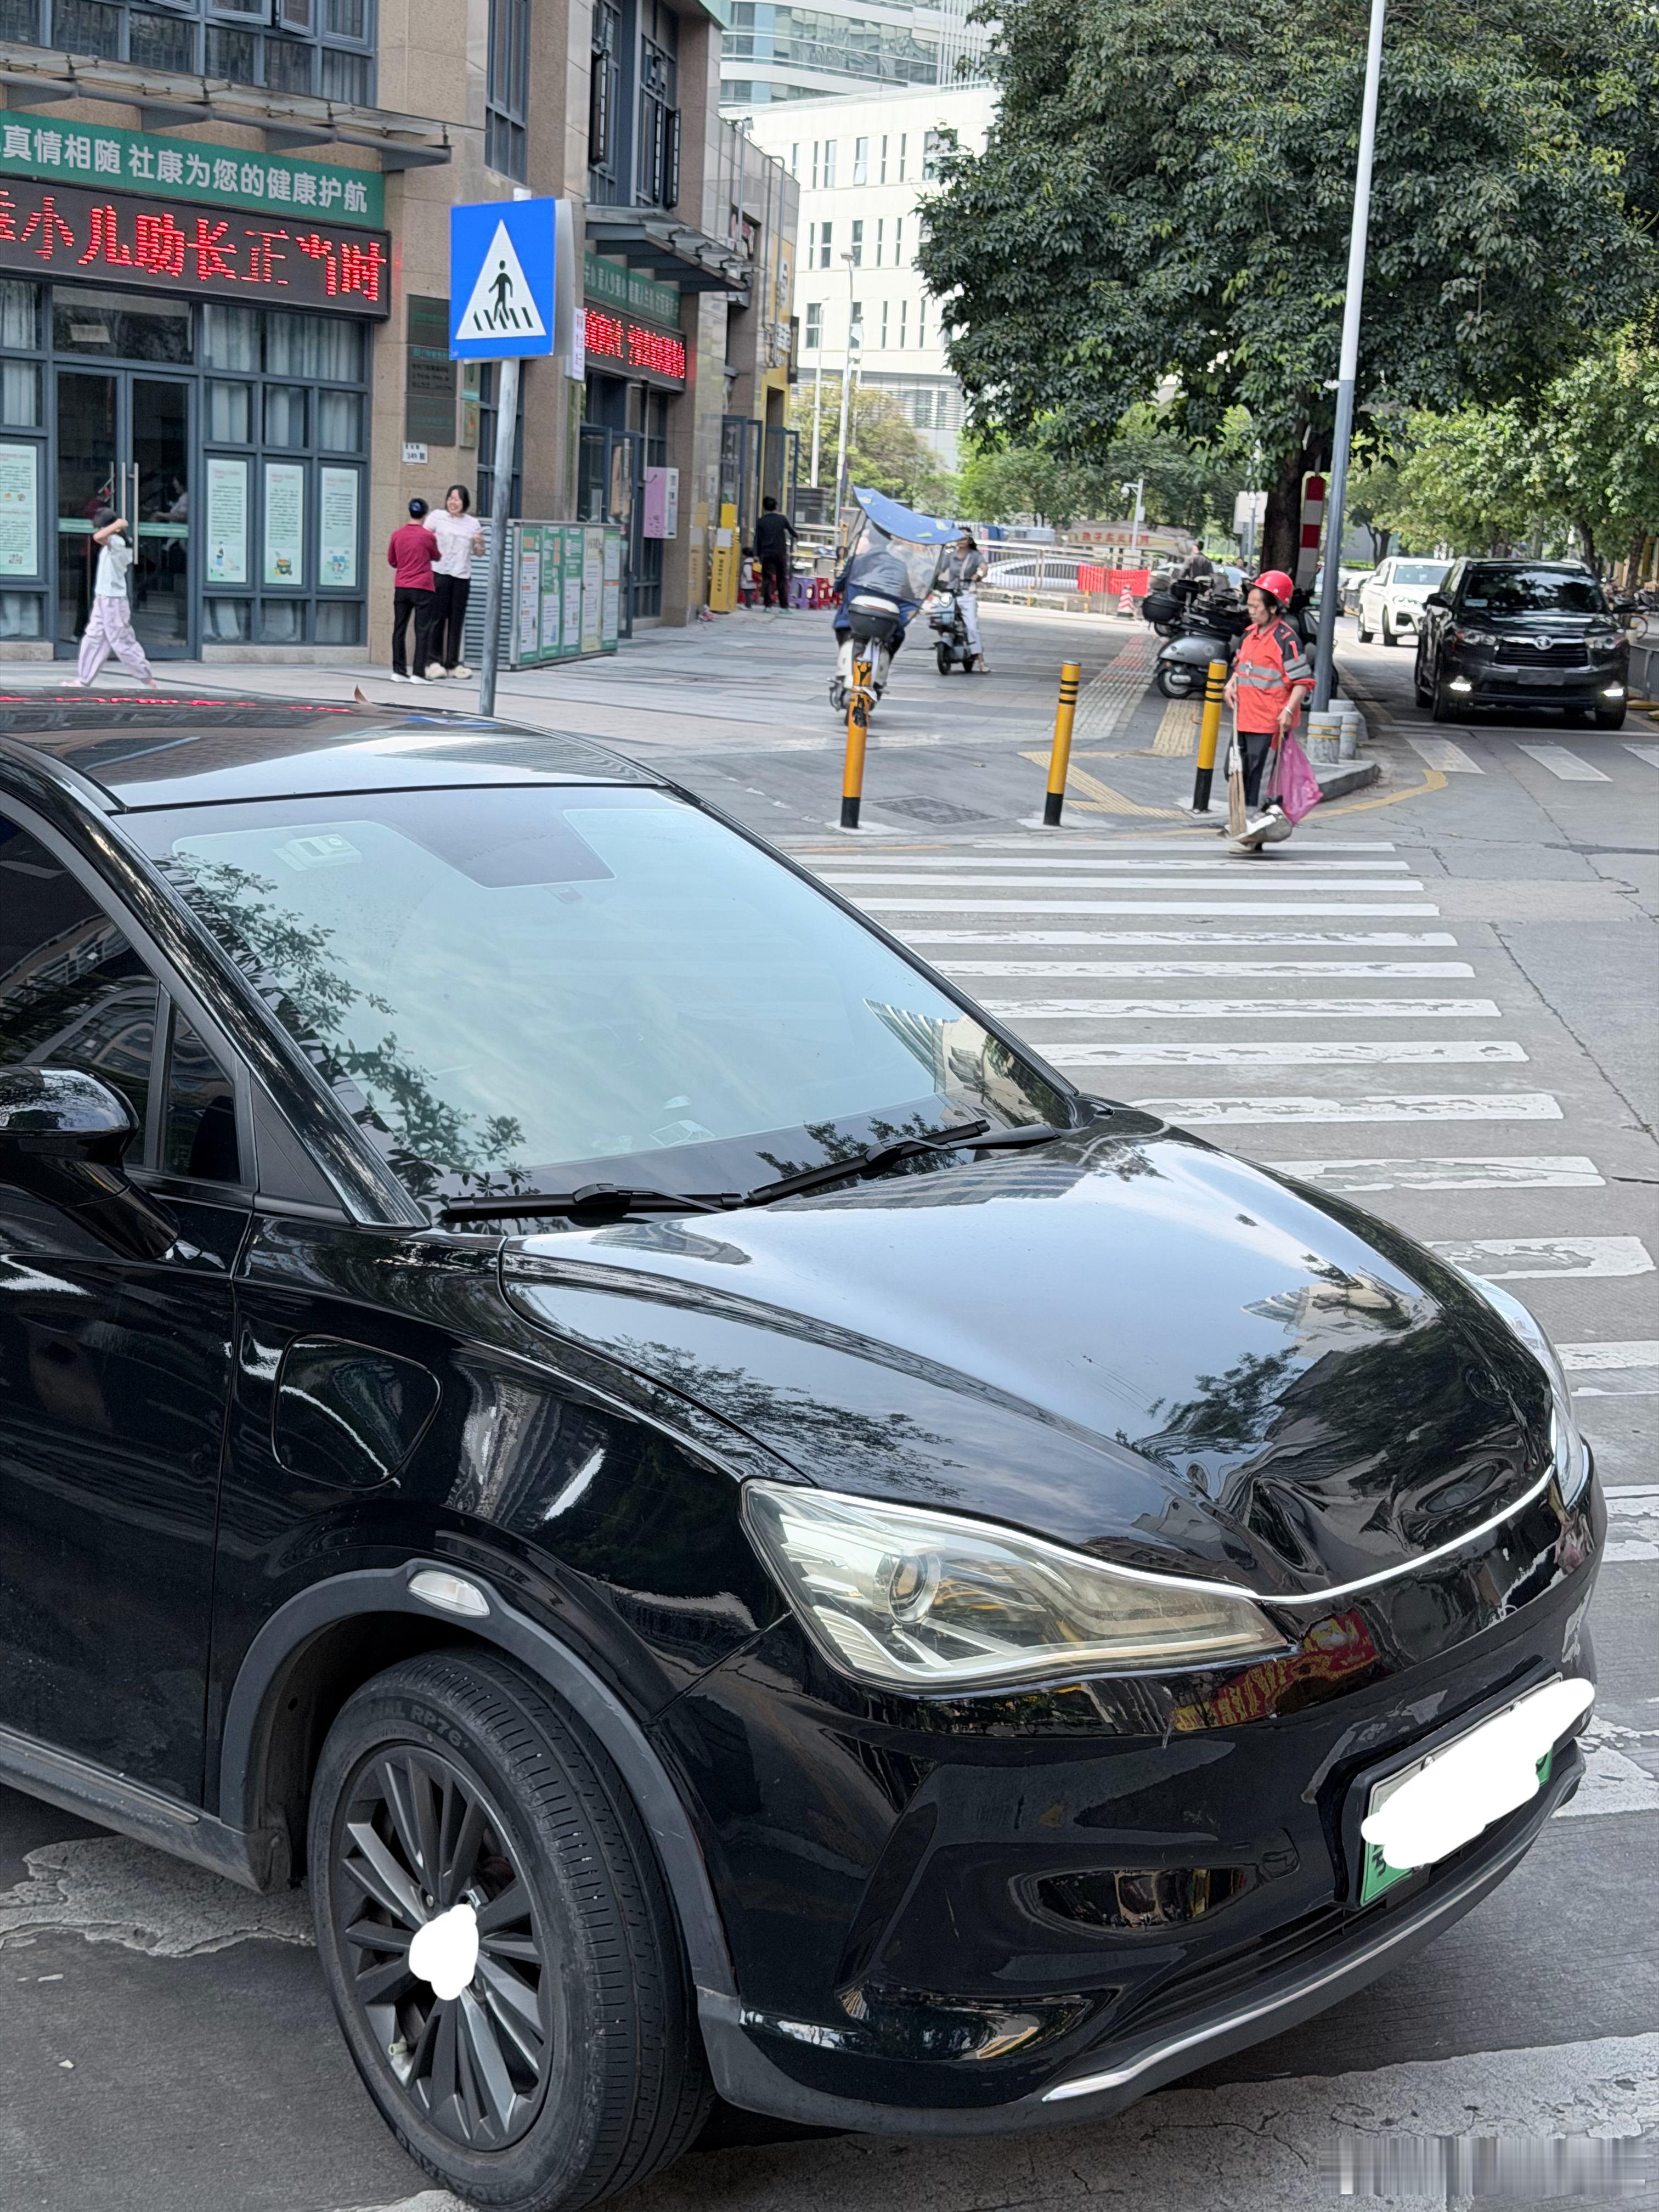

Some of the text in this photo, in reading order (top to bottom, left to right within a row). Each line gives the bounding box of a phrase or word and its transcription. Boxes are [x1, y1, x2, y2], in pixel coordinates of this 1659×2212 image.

[3, 125, 368, 214] 真情相随 社康为您的健康护航
